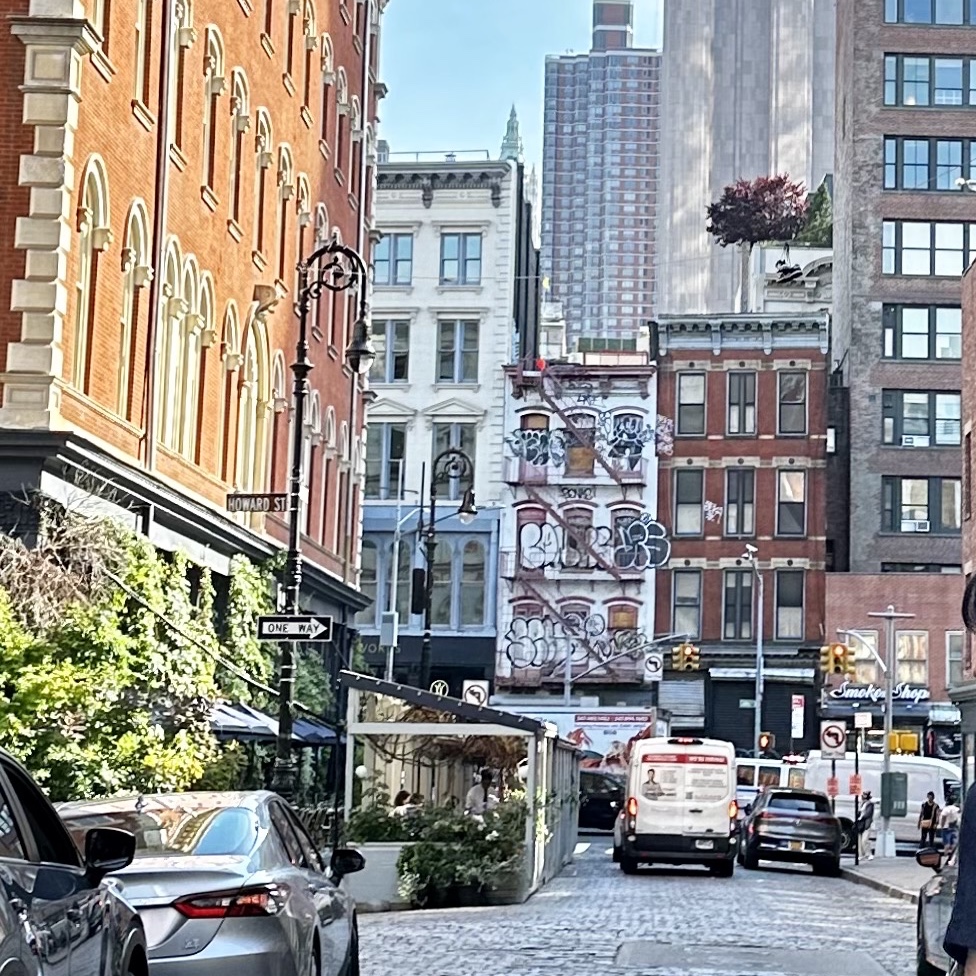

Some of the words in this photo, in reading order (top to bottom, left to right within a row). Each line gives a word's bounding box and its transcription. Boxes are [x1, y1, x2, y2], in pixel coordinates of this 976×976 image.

[228, 498, 270, 512] HOWARD
[275, 497, 287, 511] ST
[267, 623, 289, 633] ONE
[298, 623, 320, 633] WAY
[891, 682, 930, 704] Shop
